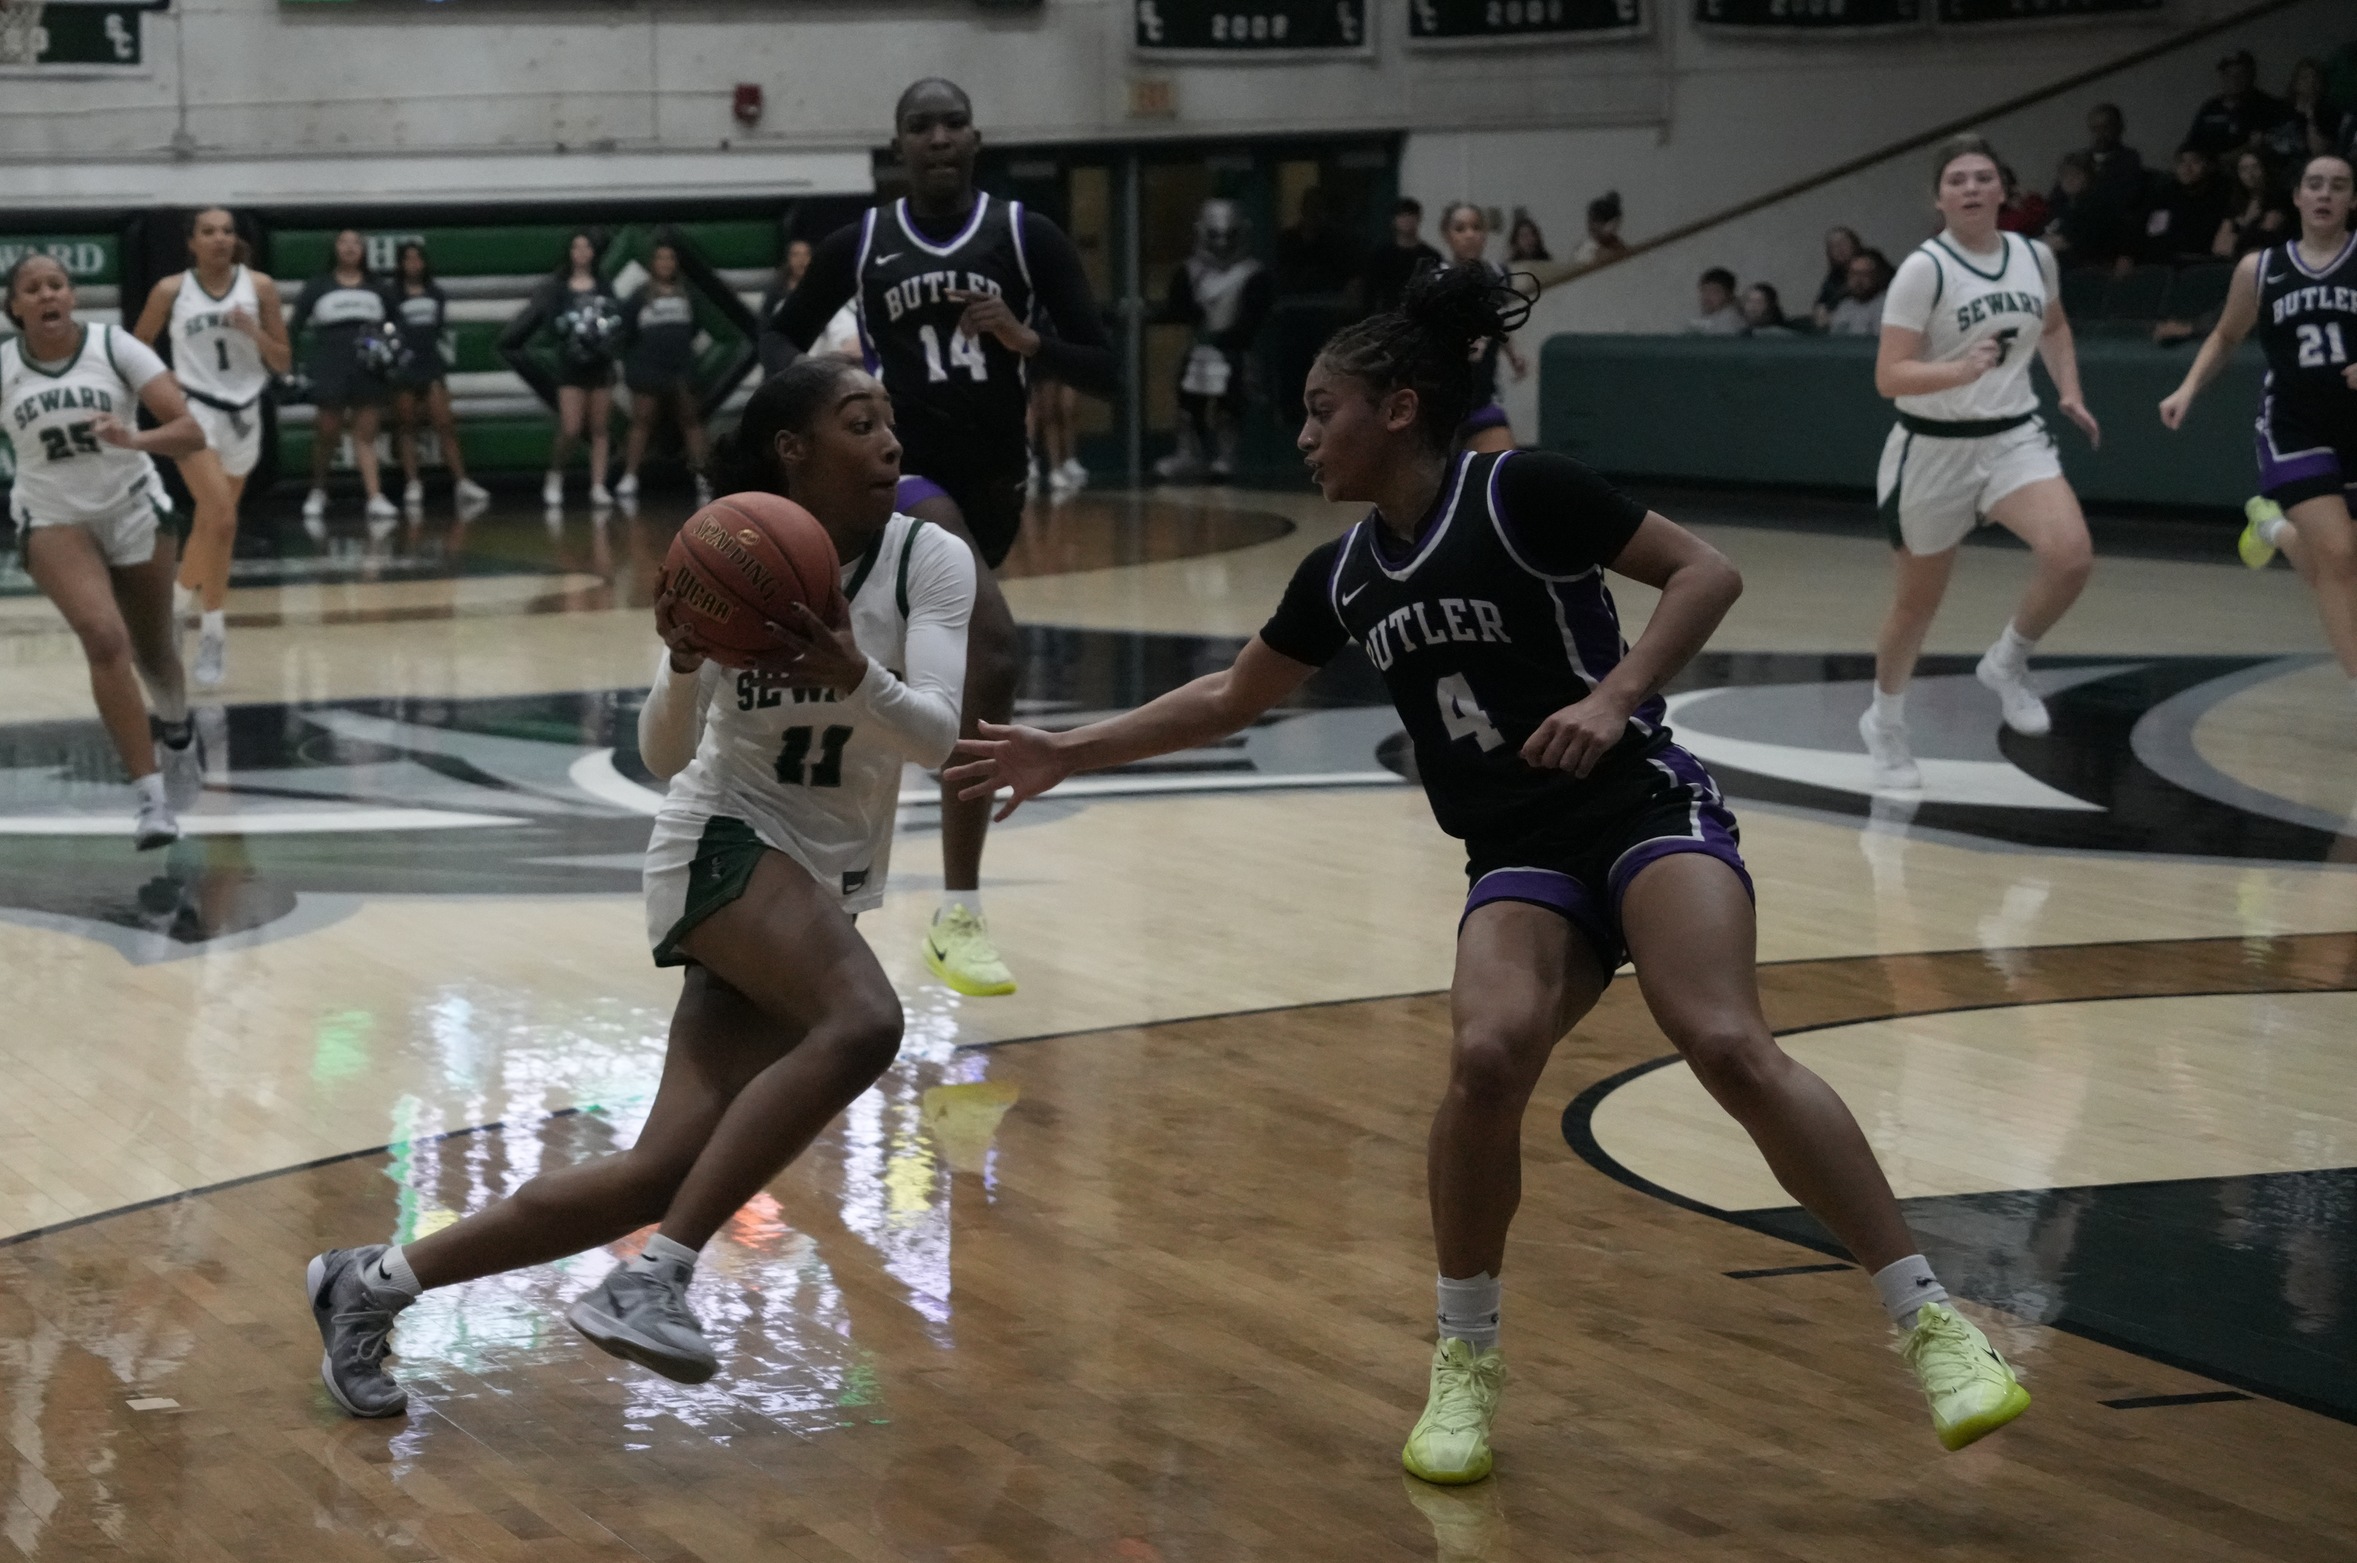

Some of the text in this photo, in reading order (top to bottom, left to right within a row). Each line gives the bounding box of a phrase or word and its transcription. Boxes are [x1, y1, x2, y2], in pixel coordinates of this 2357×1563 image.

[0, 243, 105, 273] WRD
[214, 338, 230, 371] 1
[919, 324, 988, 383] 14
[2296, 321, 2347, 368] 21
[14, 386, 112, 430] SEWARD
[39, 421, 103, 461] 25
[693, 514, 782, 601] SPALDING
[1436, 671, 1507, 753] 4
[774, 724, 854, 788] 11
